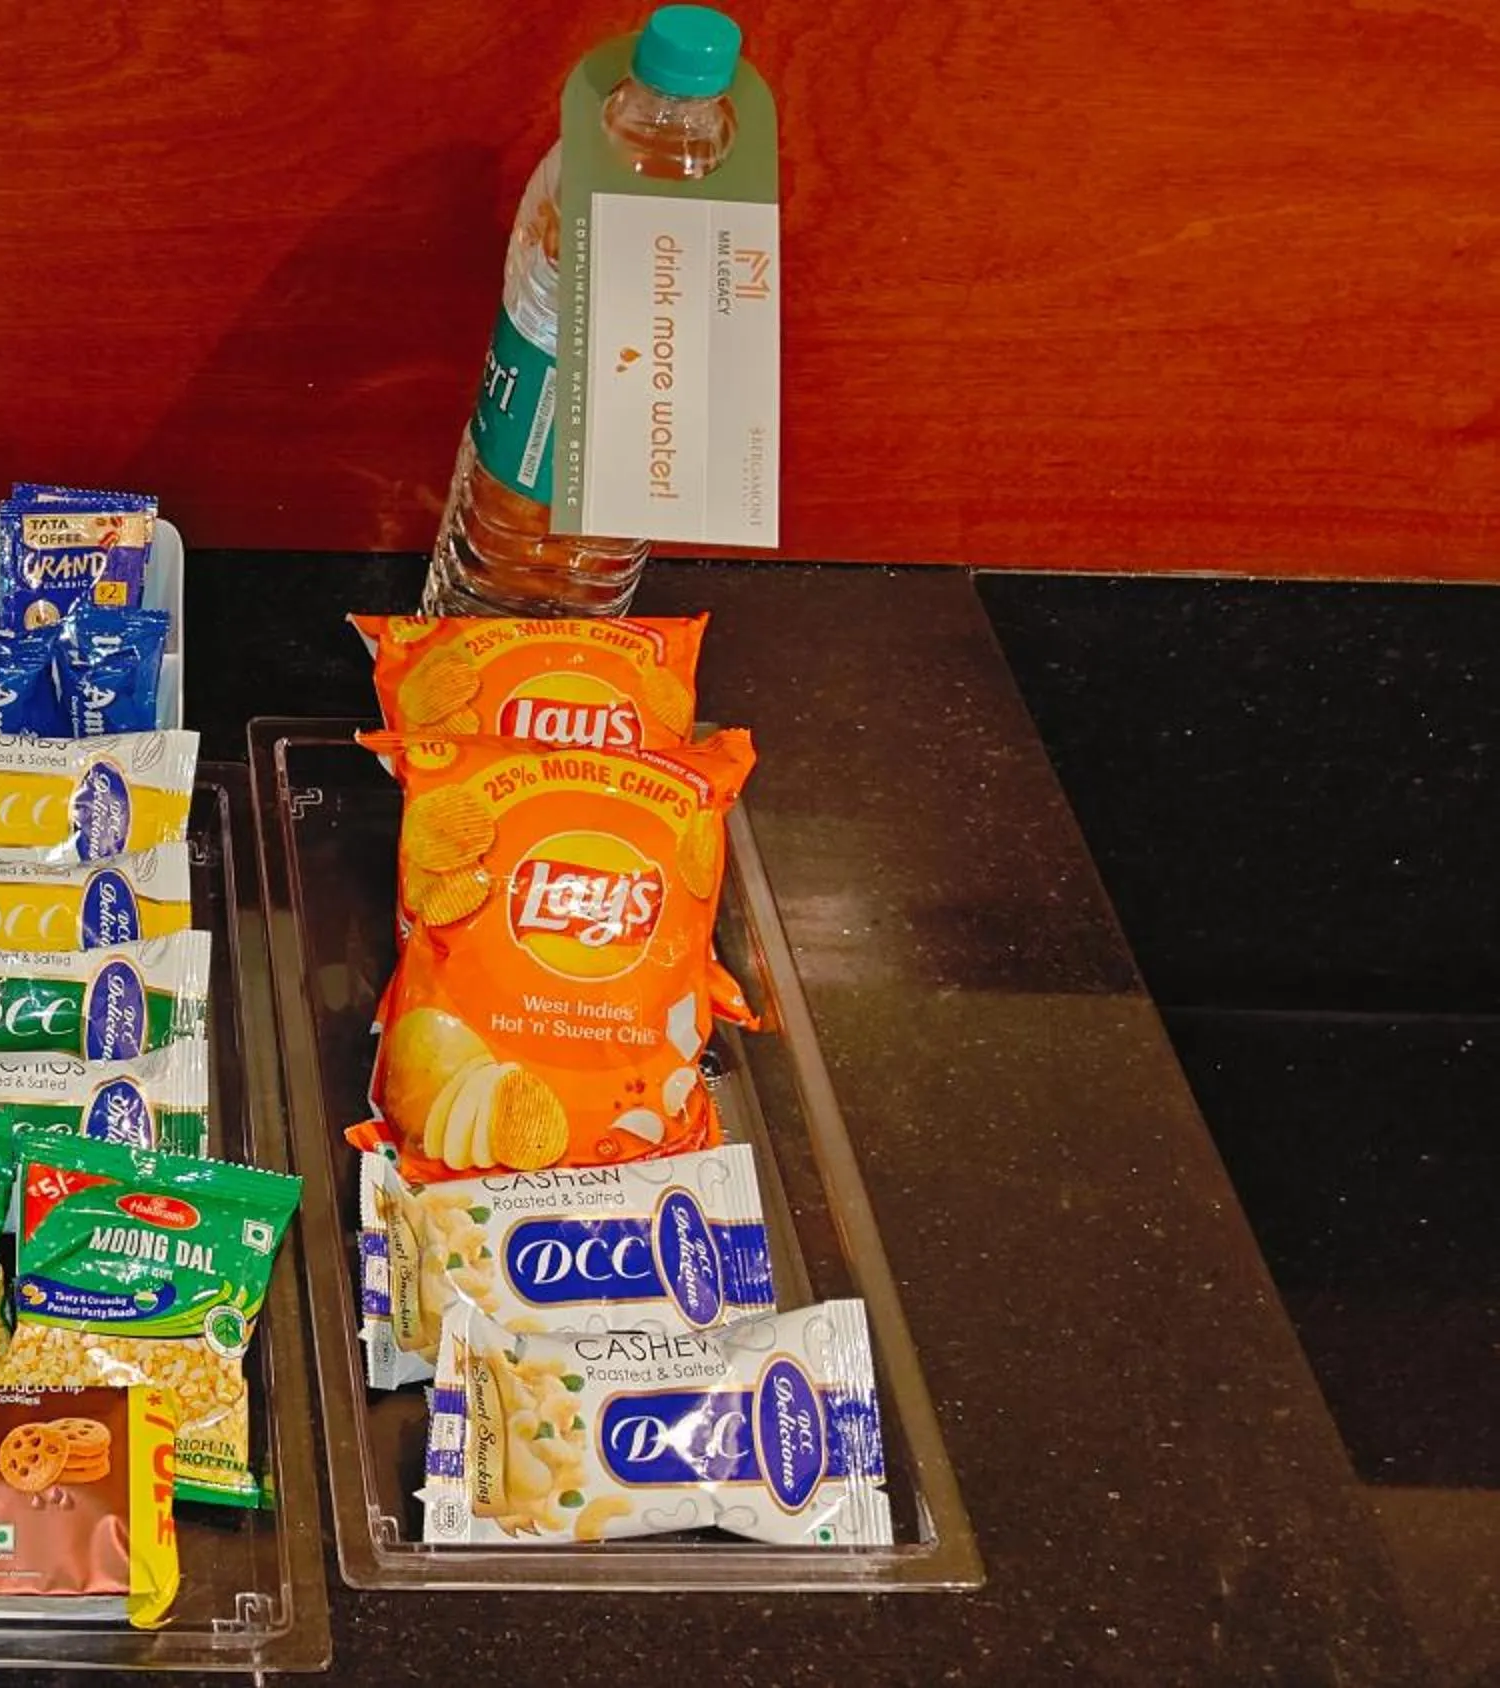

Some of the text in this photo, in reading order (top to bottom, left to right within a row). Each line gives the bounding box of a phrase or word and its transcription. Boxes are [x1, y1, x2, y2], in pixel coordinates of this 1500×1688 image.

[716, 230, 732, 316] MM LEGACY
[567, 218, 587, 506] COMPLIMENTARY WATER BOTTLE
[649, 235, 684, 499] drink more water!
[30, 518, 69, 530] TATA
[23, 551, 107, 589] GRAND
[44, 580, 88, 589] CLASSIC
[465, 627, 514, 657] 25%
[516, 622, 581, 637] MORE
[589, 627, 650, 666] CHIPS
[17, 754, 25, 764] &
[483, 765, 537, 802] 25%
[541, 759, 612, 785] MORE
[619, 769, 692, 820] CHIPS
[518, 862, 660, 947] Lay's
[22, 953, 30, 963] &
[523, 993, 571, 1014] West
[491, 1013, 524, 1034] Hot
[552, 1019, 613, 1041] Sweet
[15, 1076, 24, 1088] &
[28, 1077, 67, 1091] Salted
[492, 1190, 626, 1211] Roasted & Salted
[89, 1226, 169, 1263] MOONG
[175, 1239, 217, 1276] DAL
[516, 1237, 651, 1285] DCC
[695, 1237, 714, 1280] DCC
[585, 1360, 727, 1382] Roasted & Salted
[174, 1437, 237, 1457] RICH IN
[611, 1413, 751, 1464] DC
[773, 1375, 795, 1491] Delicious
[797, 1409, 814, 1455] DCC
